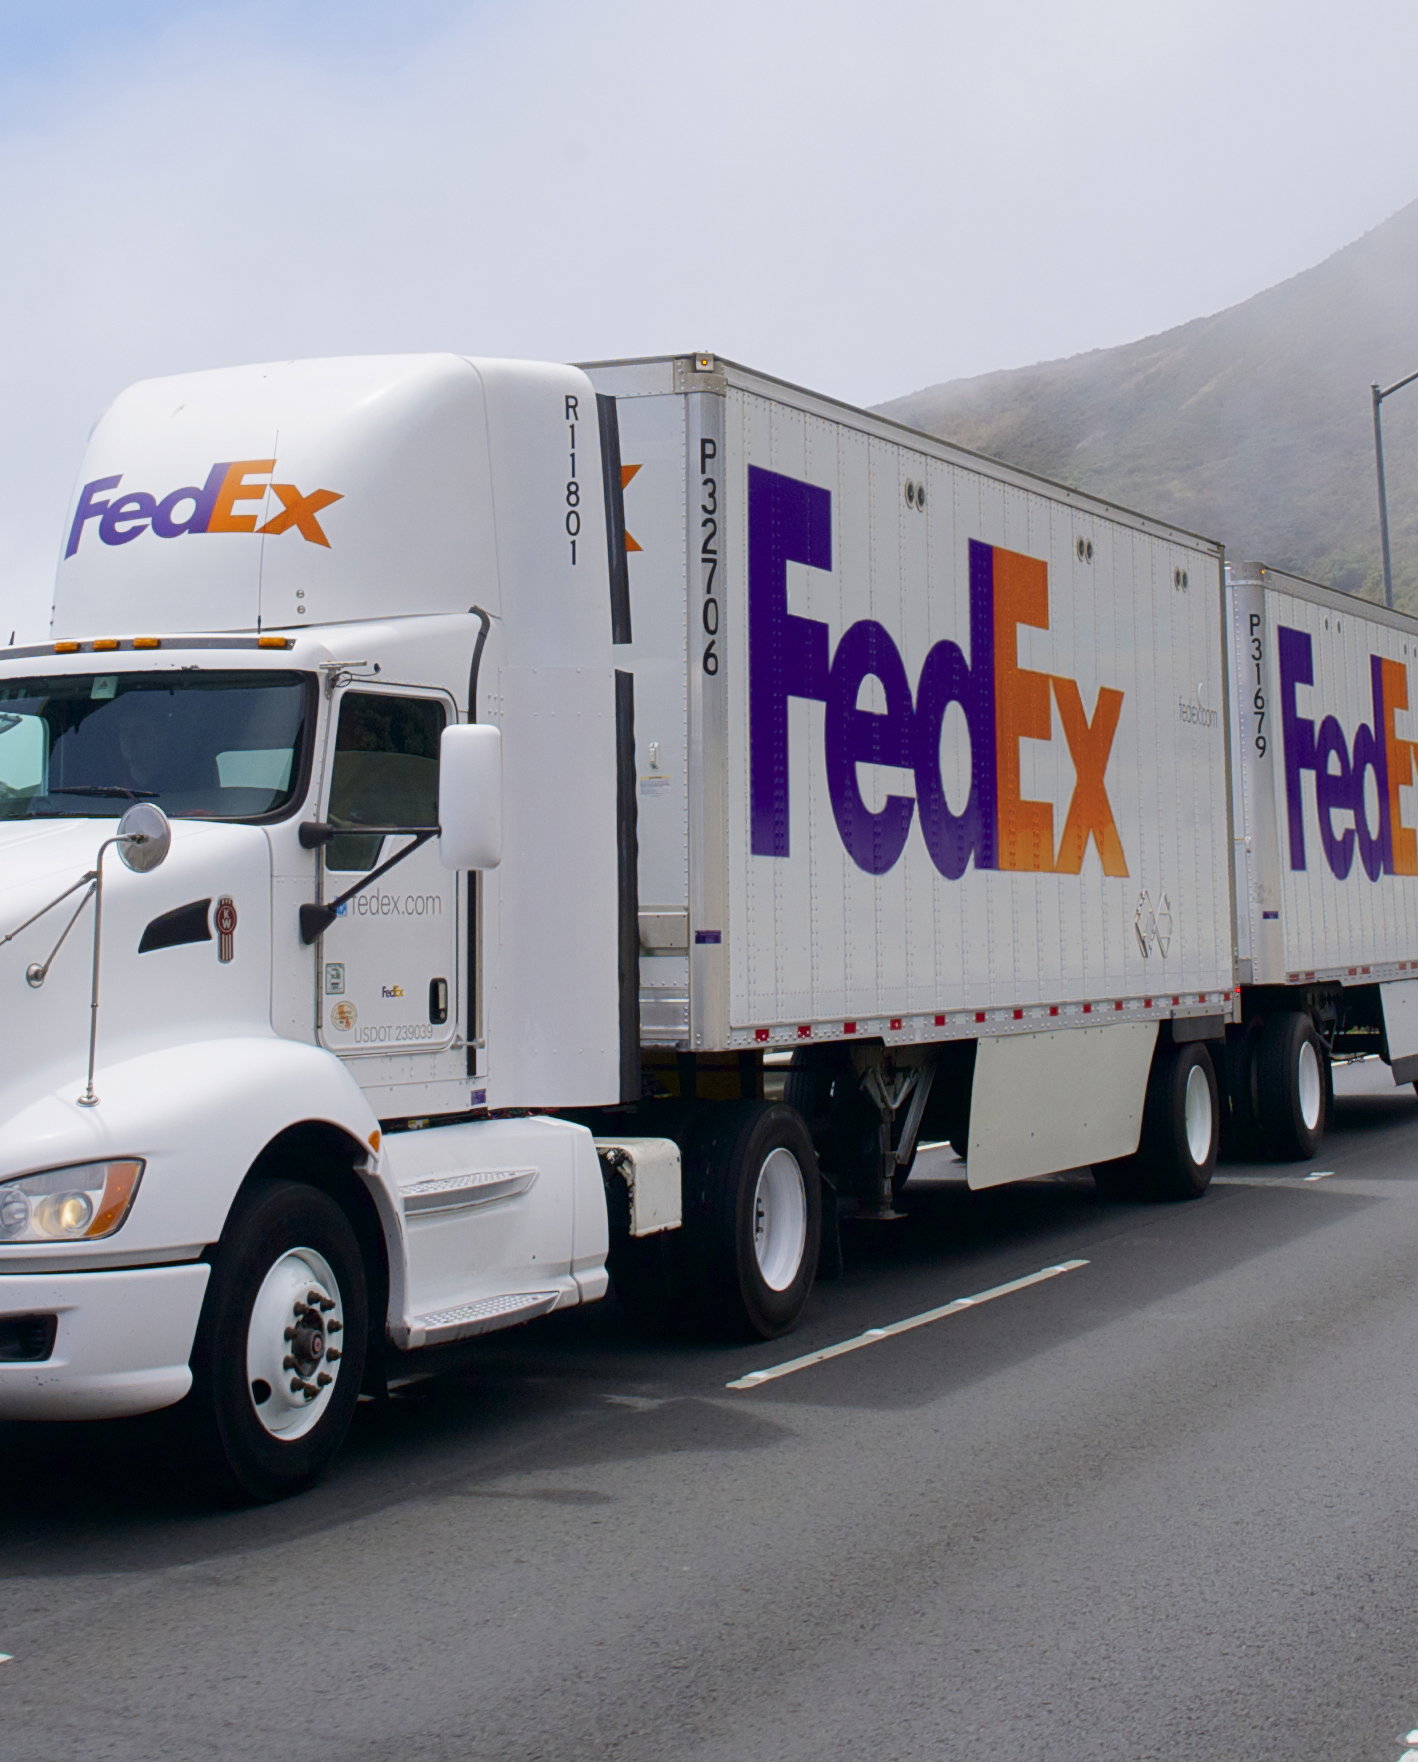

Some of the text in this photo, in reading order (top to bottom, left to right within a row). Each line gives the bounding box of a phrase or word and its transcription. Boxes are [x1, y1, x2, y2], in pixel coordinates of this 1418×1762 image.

[63, 458, 345, 561] FedEx
[565, 394, 581, 566] R11801
[700, 437, 719, 676] P32706
[747, 463, 1130, 880] FedEx
[1249, 613, 1267, 759] P31679
[351, 887, 442, 916] fedex.com
[354, 1023, 434, 1043] USDOT 239039
[382, 984, 404, 998] FedEx
